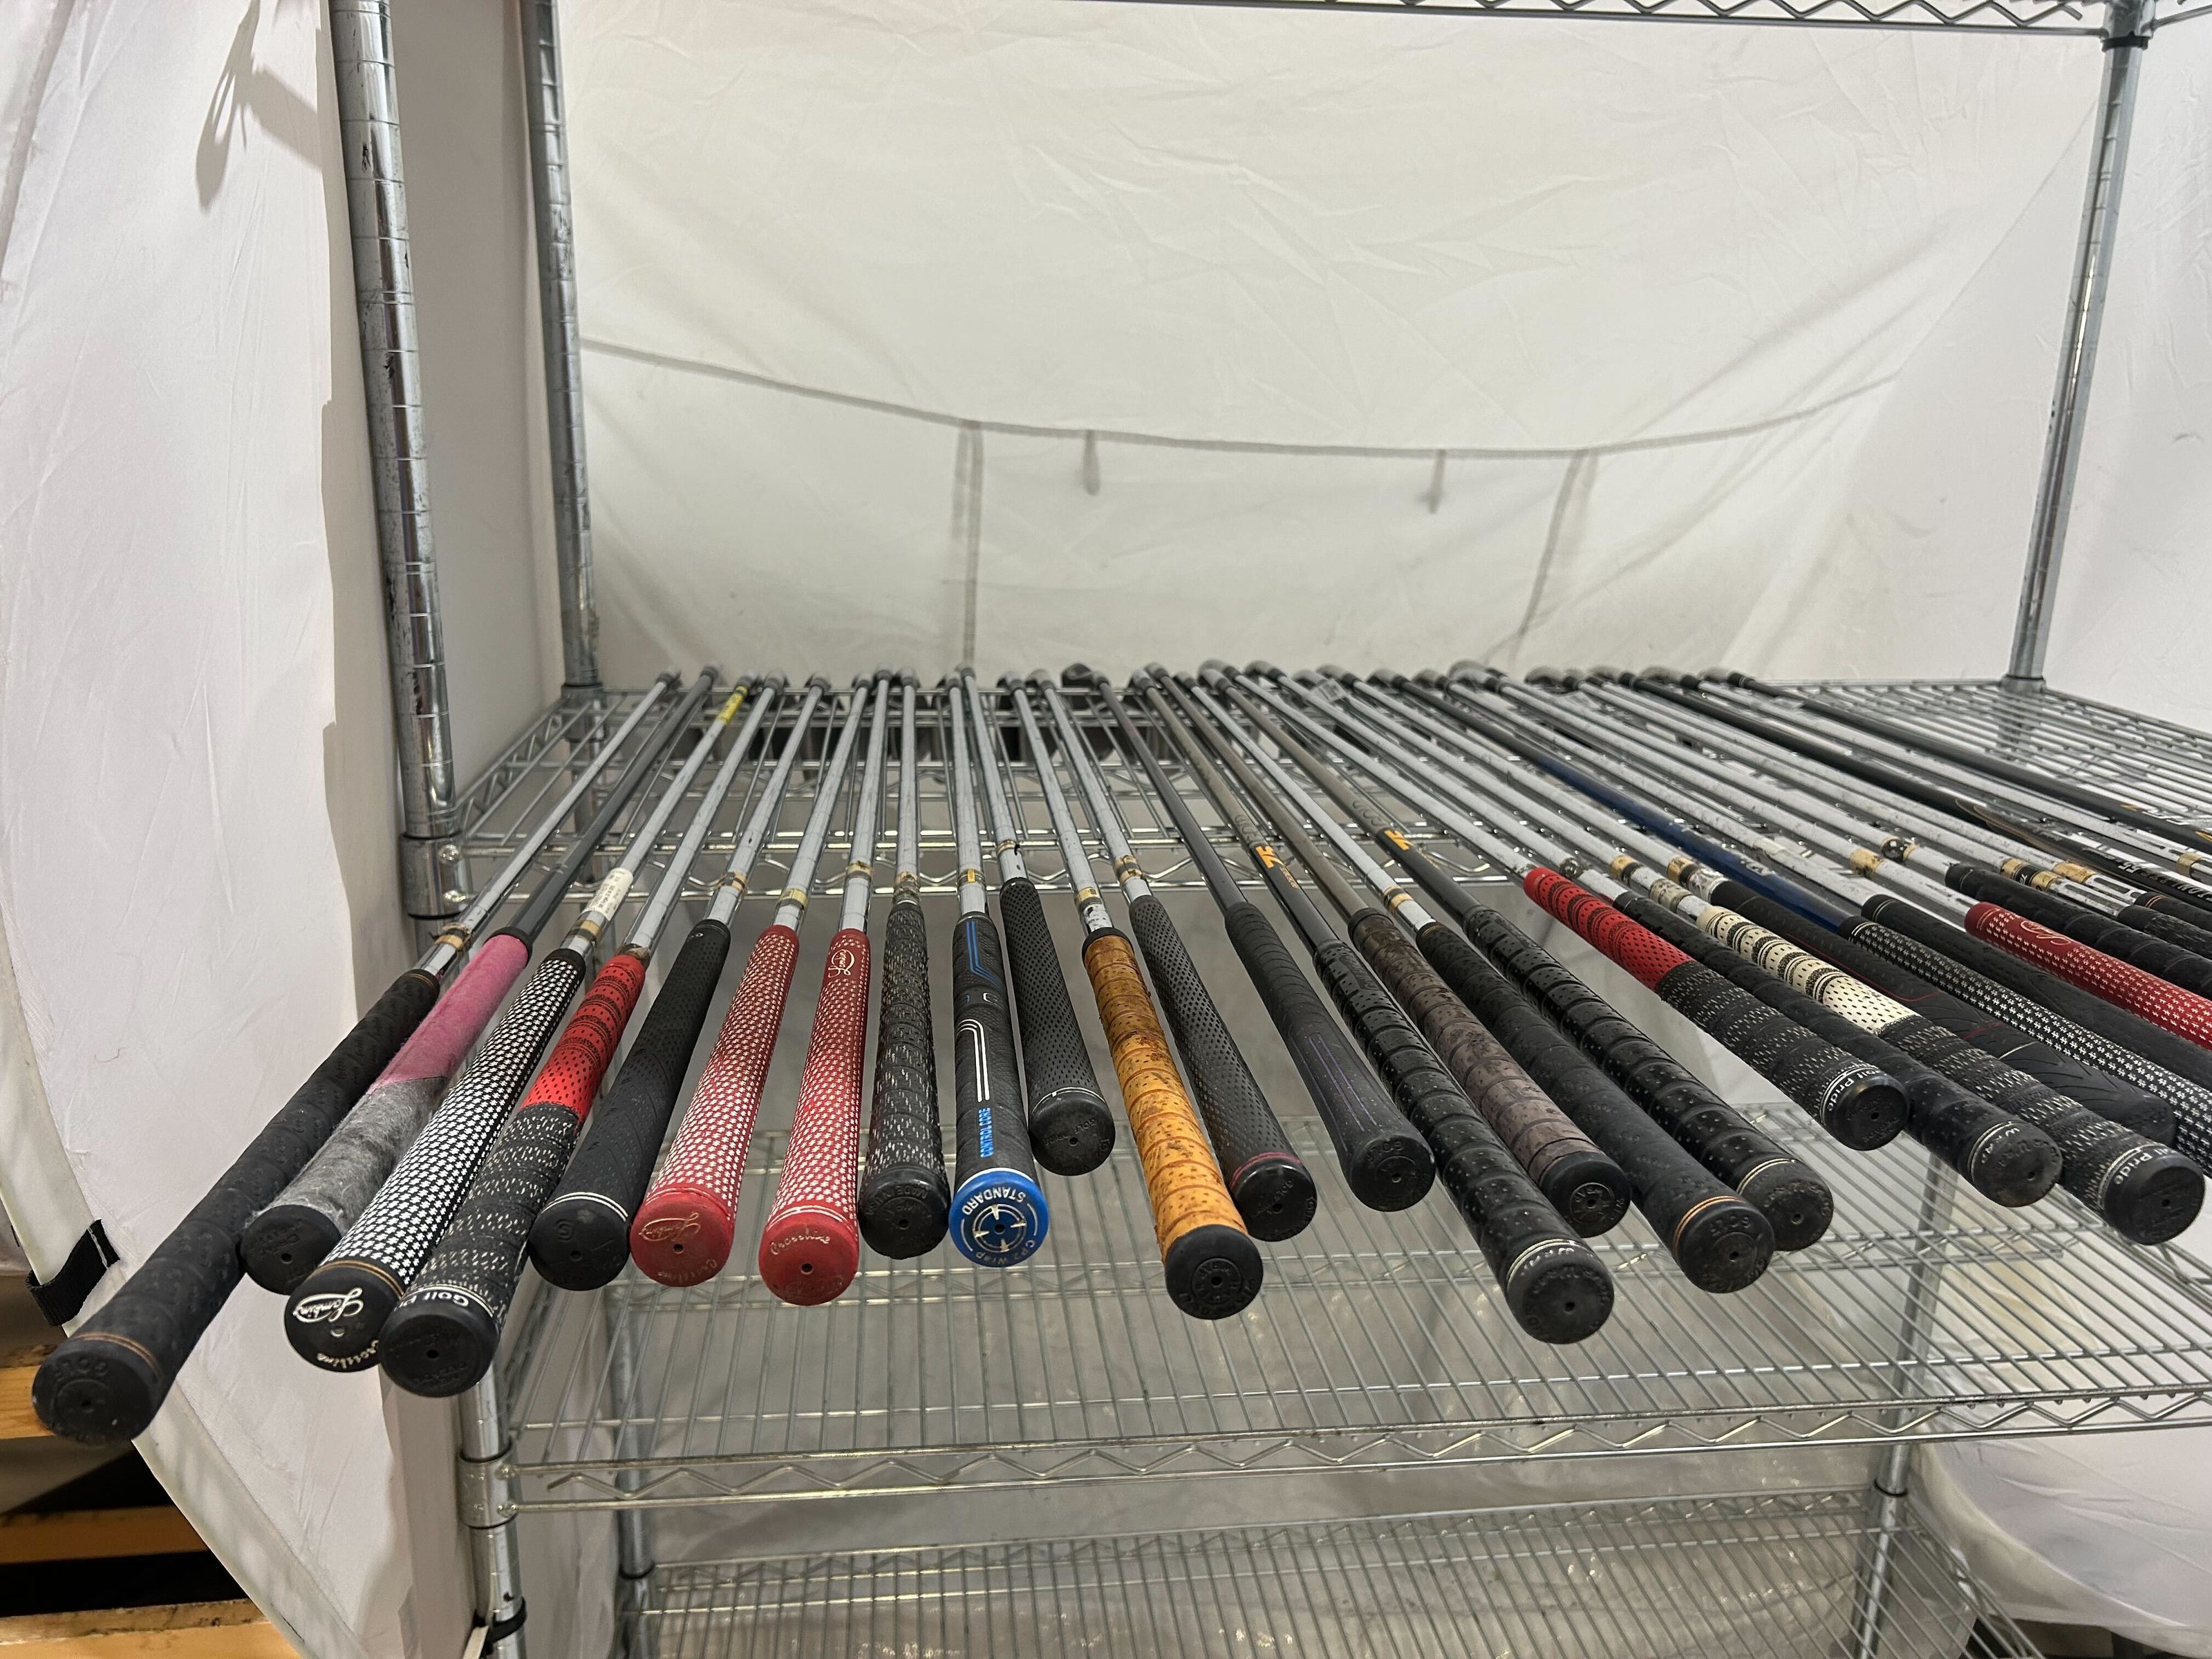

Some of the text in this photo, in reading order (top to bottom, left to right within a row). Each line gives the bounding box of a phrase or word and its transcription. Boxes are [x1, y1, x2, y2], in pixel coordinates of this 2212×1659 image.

[1255, 845, 1285, 869] 75
[2117, 862, 2142, 874] 55
[1827, 1077, 1855, 1112] Pride
[978, 1107, 995, 1159] CORE CONTROL
[2113, 1152, 2153, 1185] Pride
[961, 1186, 1027, 1217] STANDARD
[975, 1250, 1008, 1265] Wrap
[422, 1290, 469, 1308] Golf
